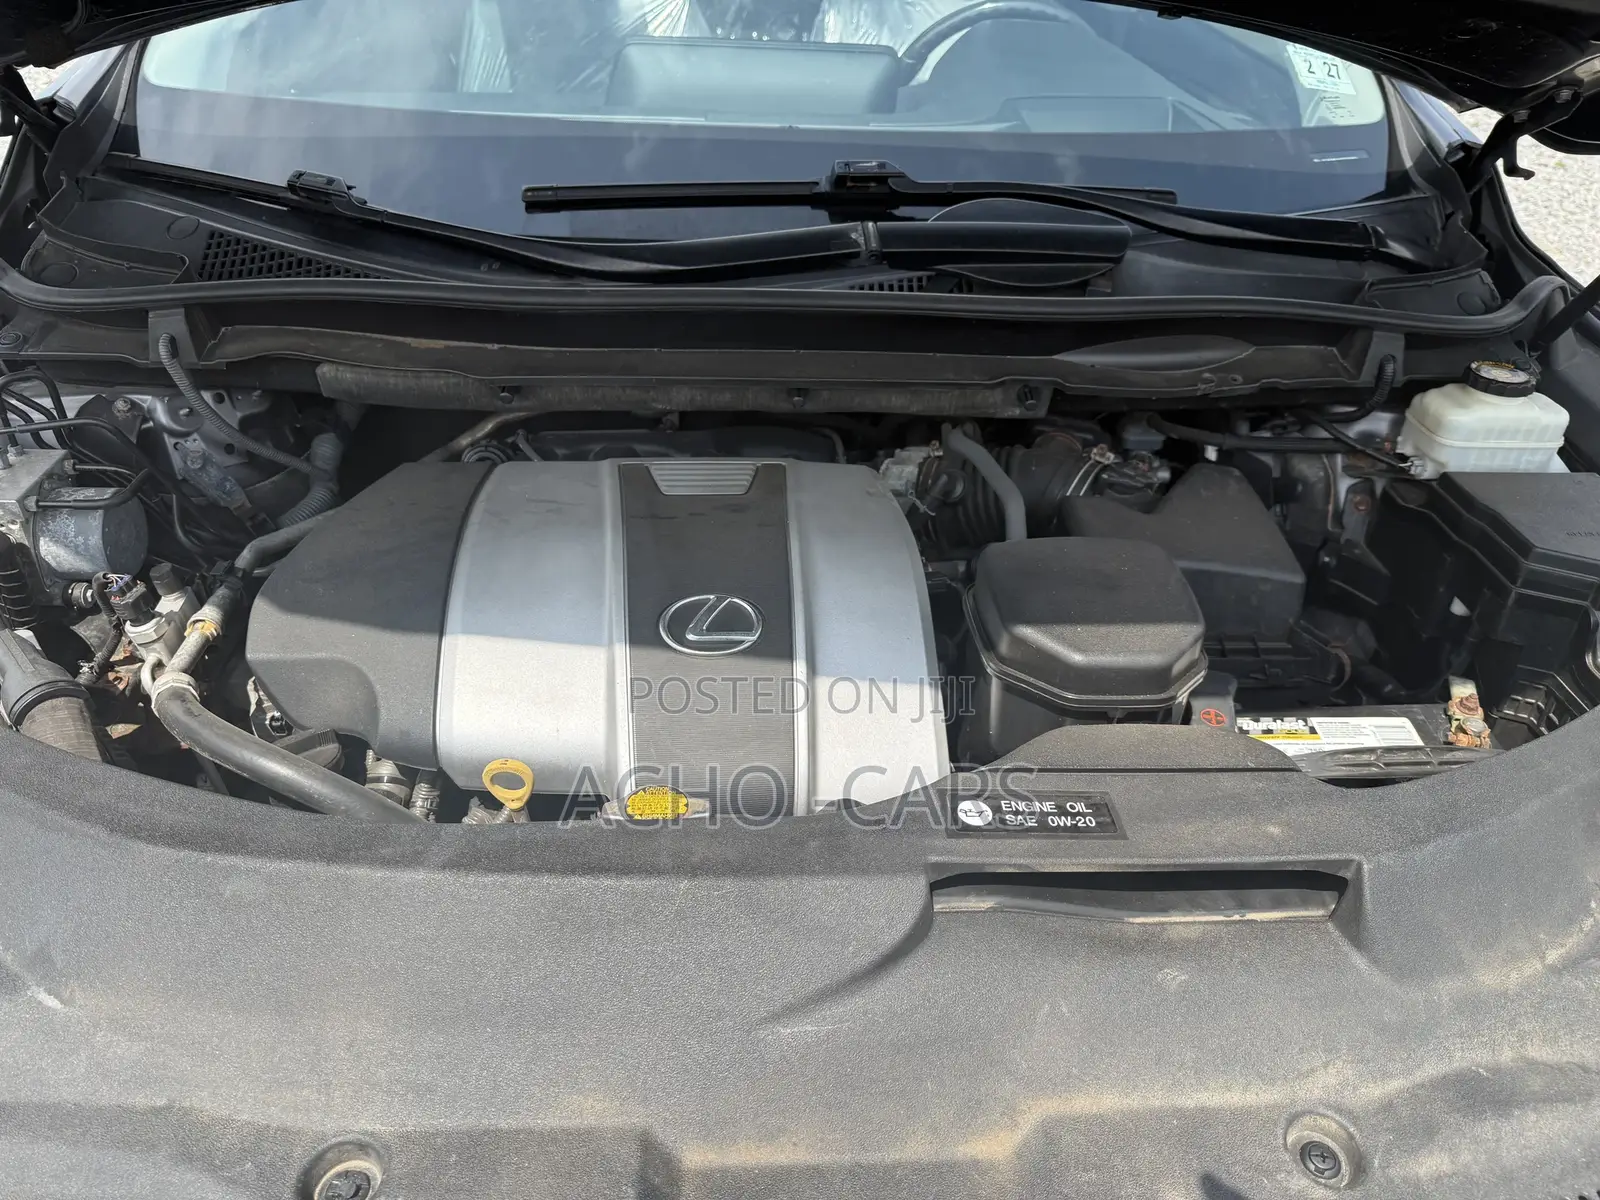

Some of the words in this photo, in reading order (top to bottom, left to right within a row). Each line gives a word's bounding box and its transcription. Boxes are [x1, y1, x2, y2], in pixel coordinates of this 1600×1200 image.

[1307, 60, 1316, 75] 2
[1322, 61, 1341, 80] 27
[1242, 719, 1307, 731] Duralast
[1001, 800, 1058, 813] ENGINE
[1066, 802, 1093, 813] OIL
[1005, 815, 1038, 827] SAE
[1048, 816, 1096, 827] 0W-20
